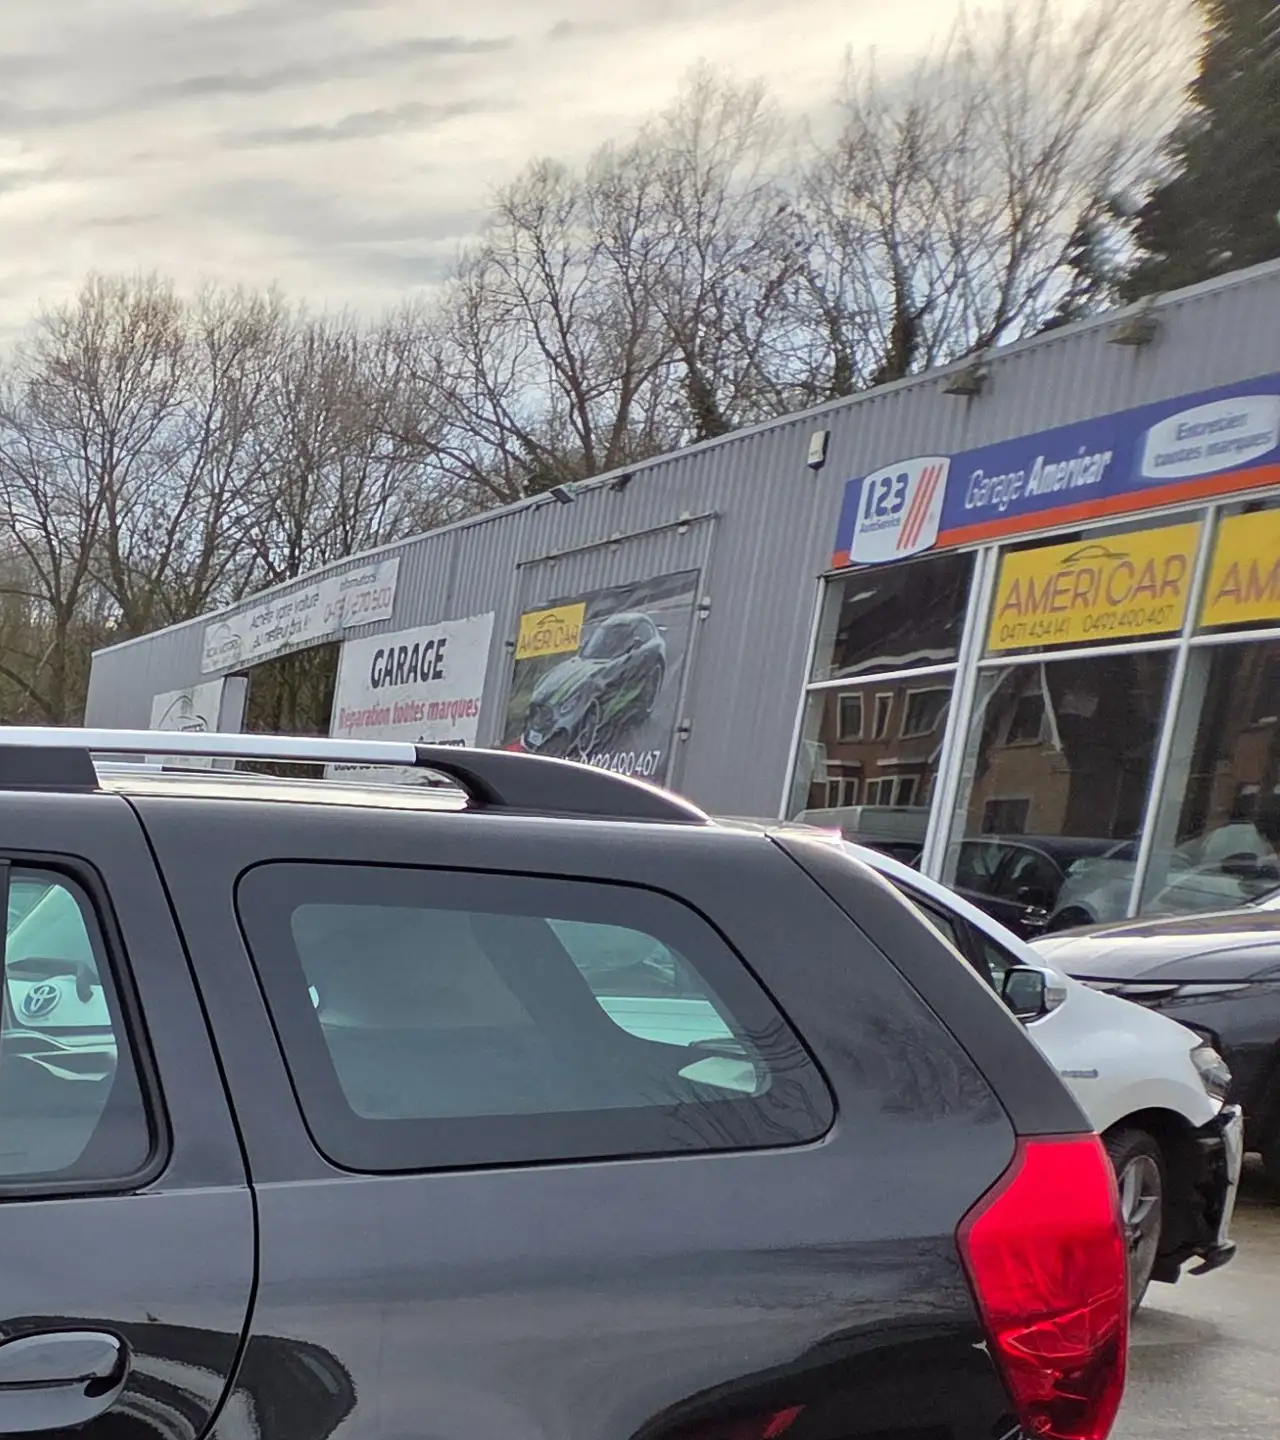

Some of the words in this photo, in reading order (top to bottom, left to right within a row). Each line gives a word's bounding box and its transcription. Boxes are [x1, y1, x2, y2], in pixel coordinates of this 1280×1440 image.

[964, 467, 1026, 513] Garage
[1026, 445, 1116, 496] Americar
[370, 638, 447, 690] GARAGE
[393, 699, 425, 724] toutes
[427, 697, 480, 728] marques
